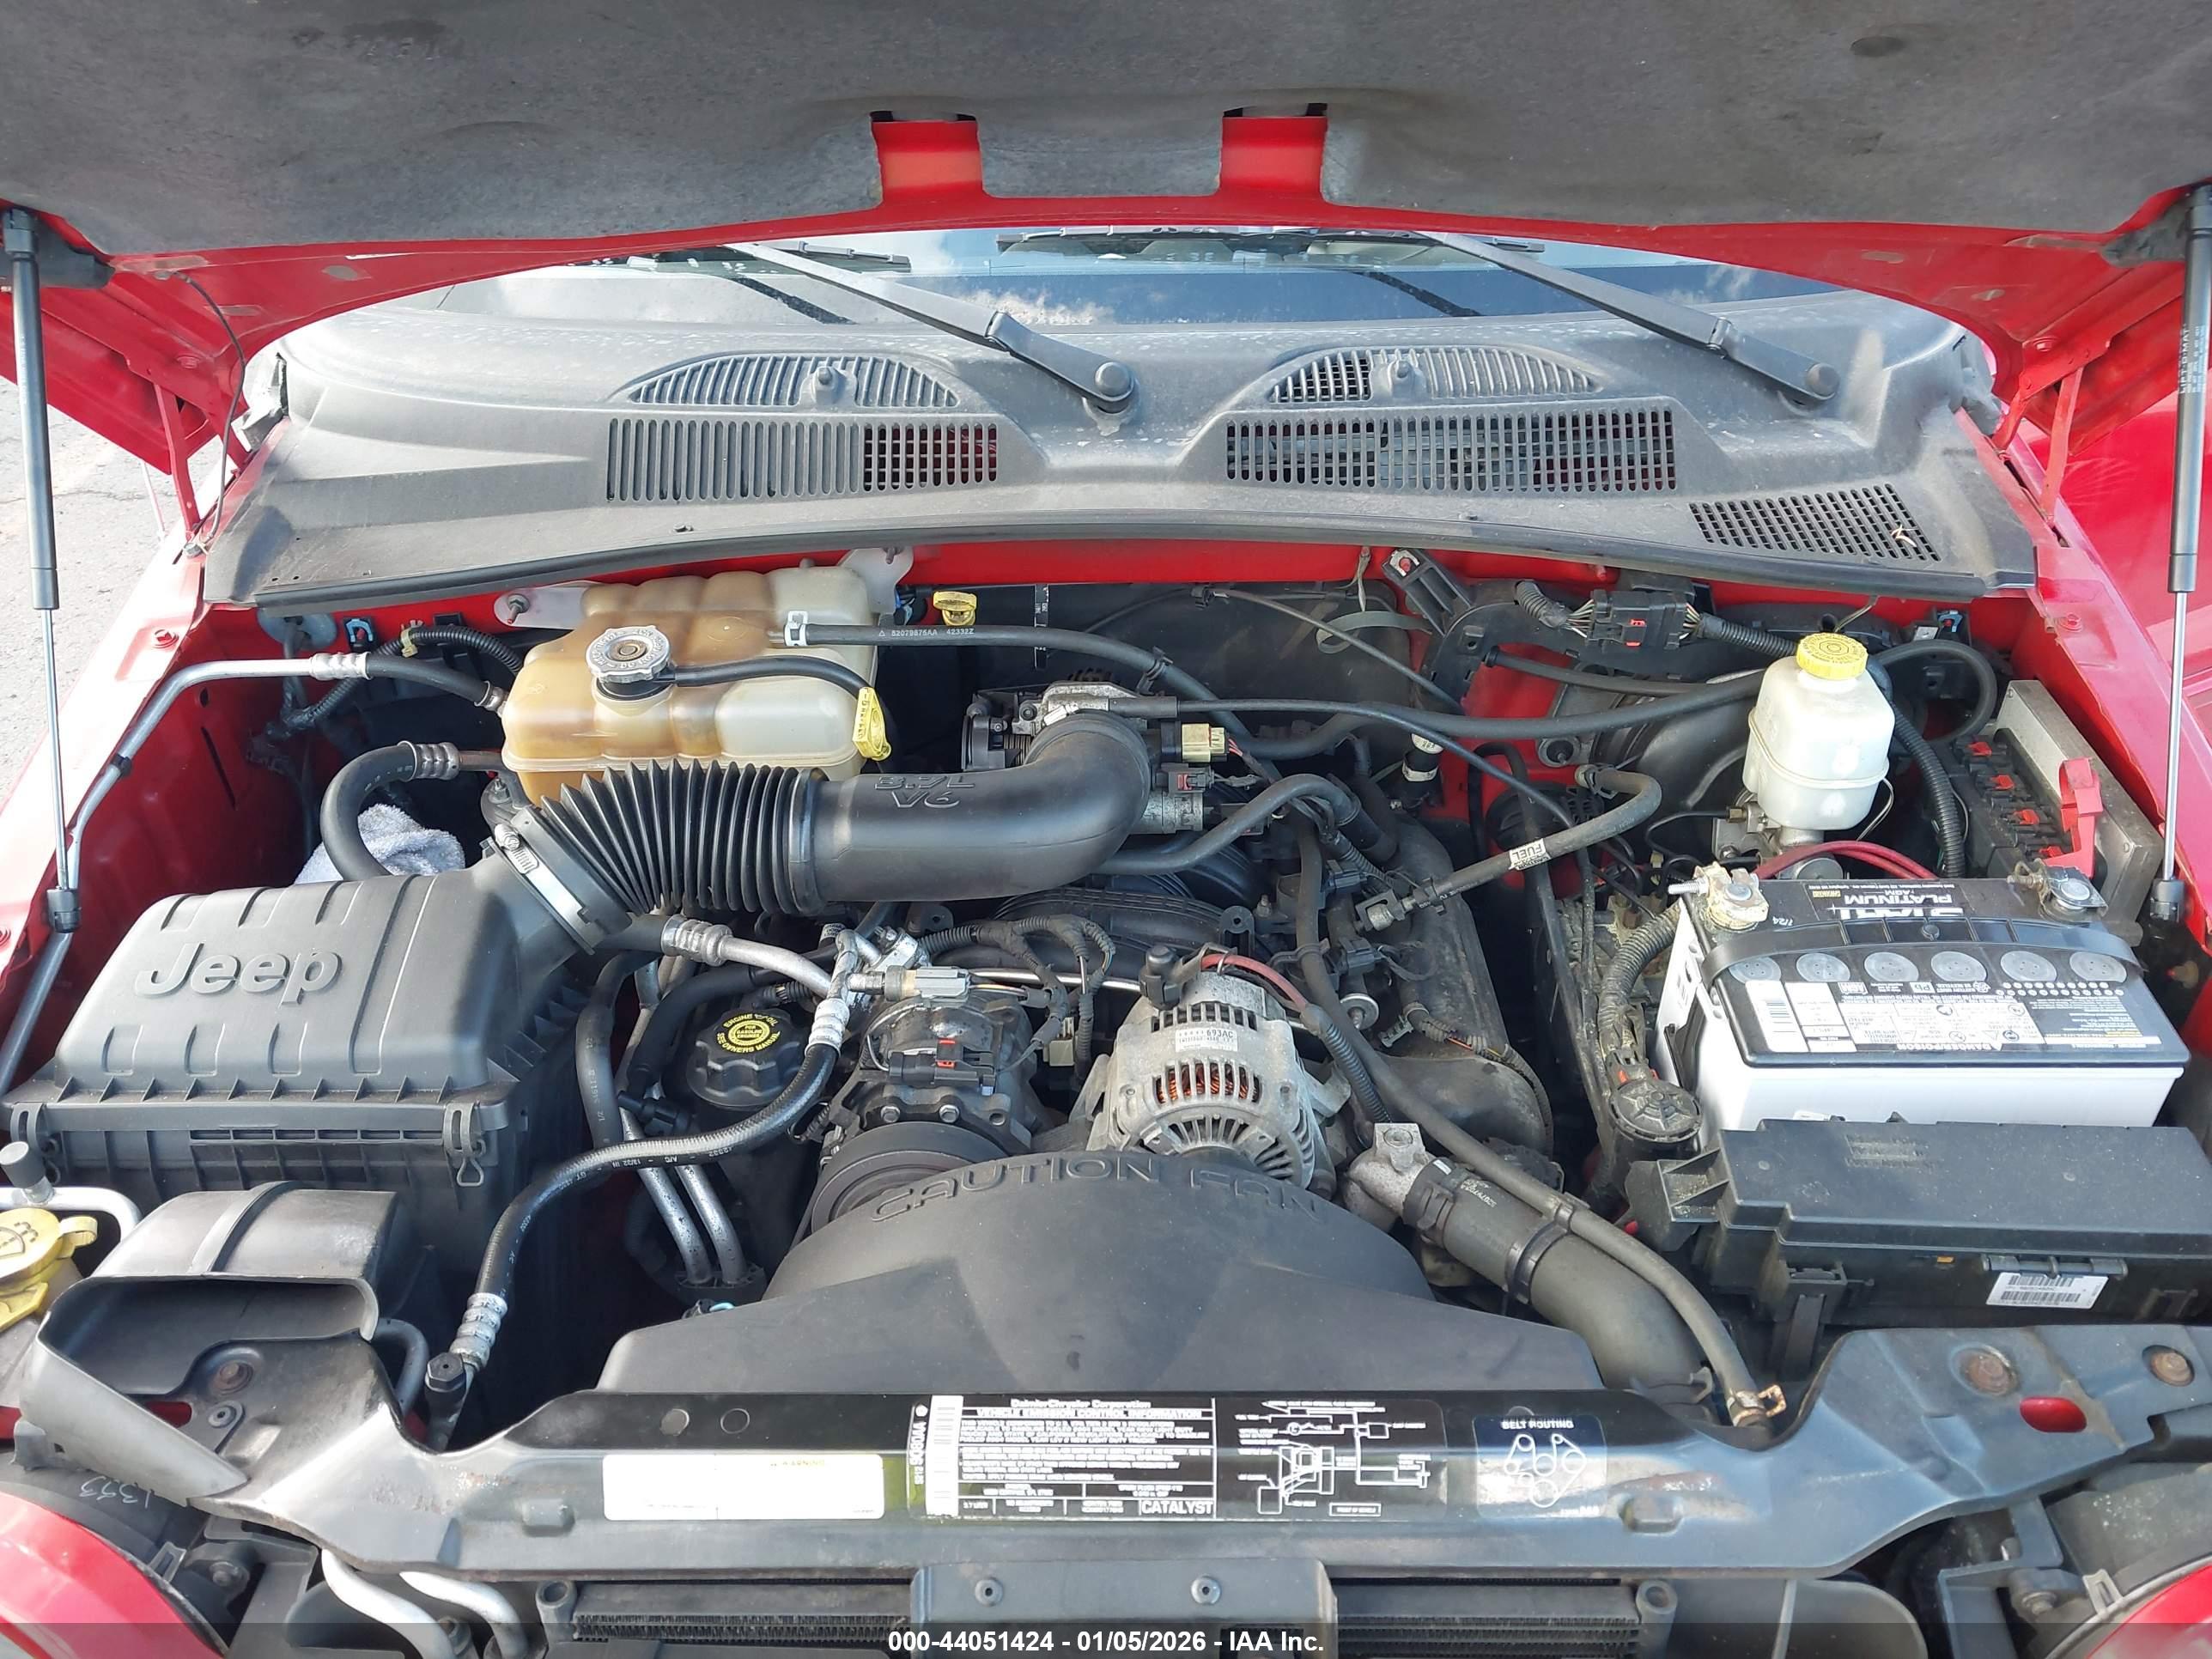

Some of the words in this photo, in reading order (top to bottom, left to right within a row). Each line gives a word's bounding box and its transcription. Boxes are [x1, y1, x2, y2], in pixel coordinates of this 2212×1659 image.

[874, 775, 976, 790] 3.7L
[891, 790, 961, 810] V6
[1511, 843, 1543, 860] FUEL
[1844, 893, 1954, 905] PLATINUM
[135, 940, 343, 1006] Jeep
[723, 1013, 753, 1028] ENGINE
[766, 1017, 779, 1027] OIL
[716, 1032, 726, 1045] SEE
[721, 1043, 755, 1054] OWNERS
[755, 1030, 781, 1051] MANUAL
[872, 1151, 1158, 1223] CAUTION
[1189, 1166, 1318, 1223] FAN
[1077, 1409, 1127, 1418] CONTROL
[1127, 1409, 1201, 1419] INFORMATION
[1500, 1420, 1528, 1430] BELT
[1528, 1419, 1575, 1429] ROUTING
[1141, 1500, 1213, 1514] CATALYST
